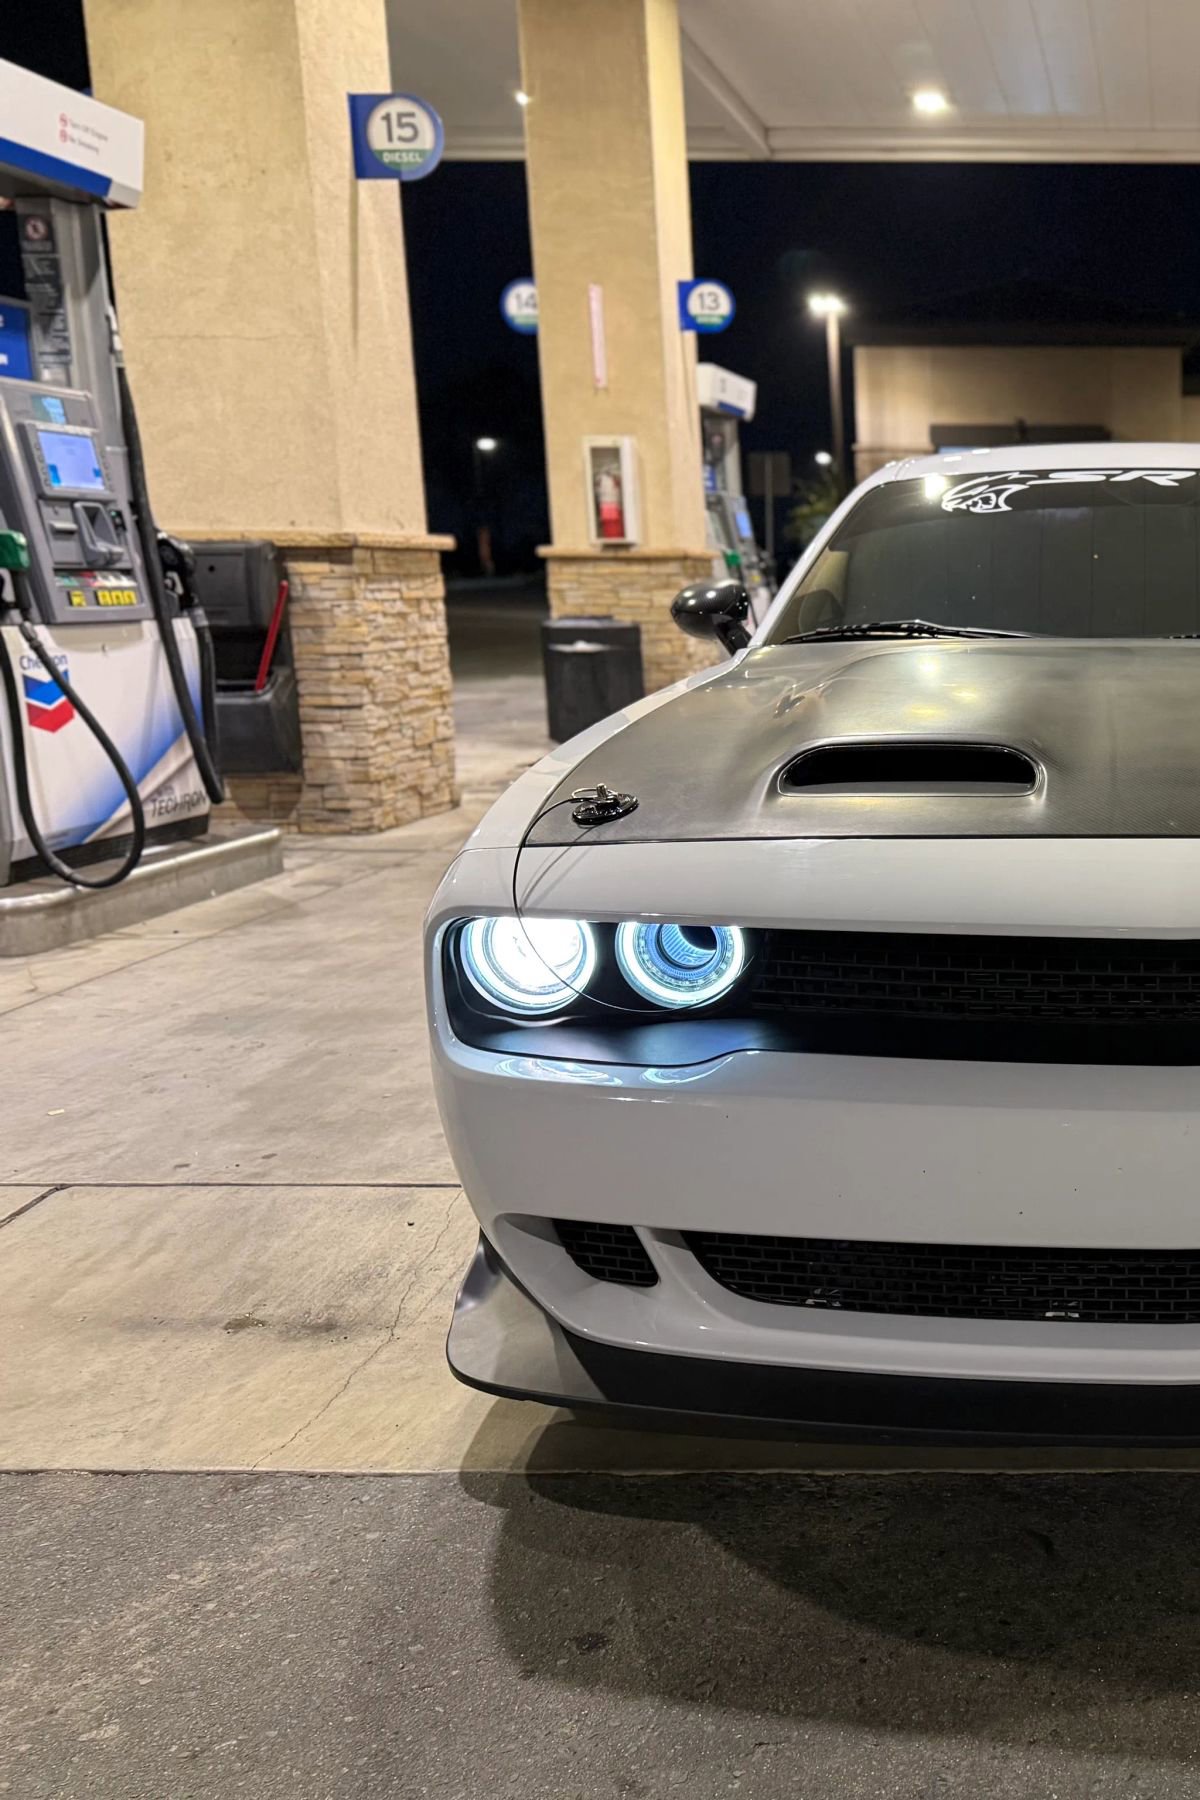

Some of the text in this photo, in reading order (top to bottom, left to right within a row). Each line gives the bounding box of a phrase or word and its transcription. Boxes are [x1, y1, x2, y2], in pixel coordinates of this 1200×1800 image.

[380, 111, 419, 144] 15
[382, 151, 424, 164] DIESEL
[697, 290, 721, 312] 13
[19, 655, 69, 671] Cheon
